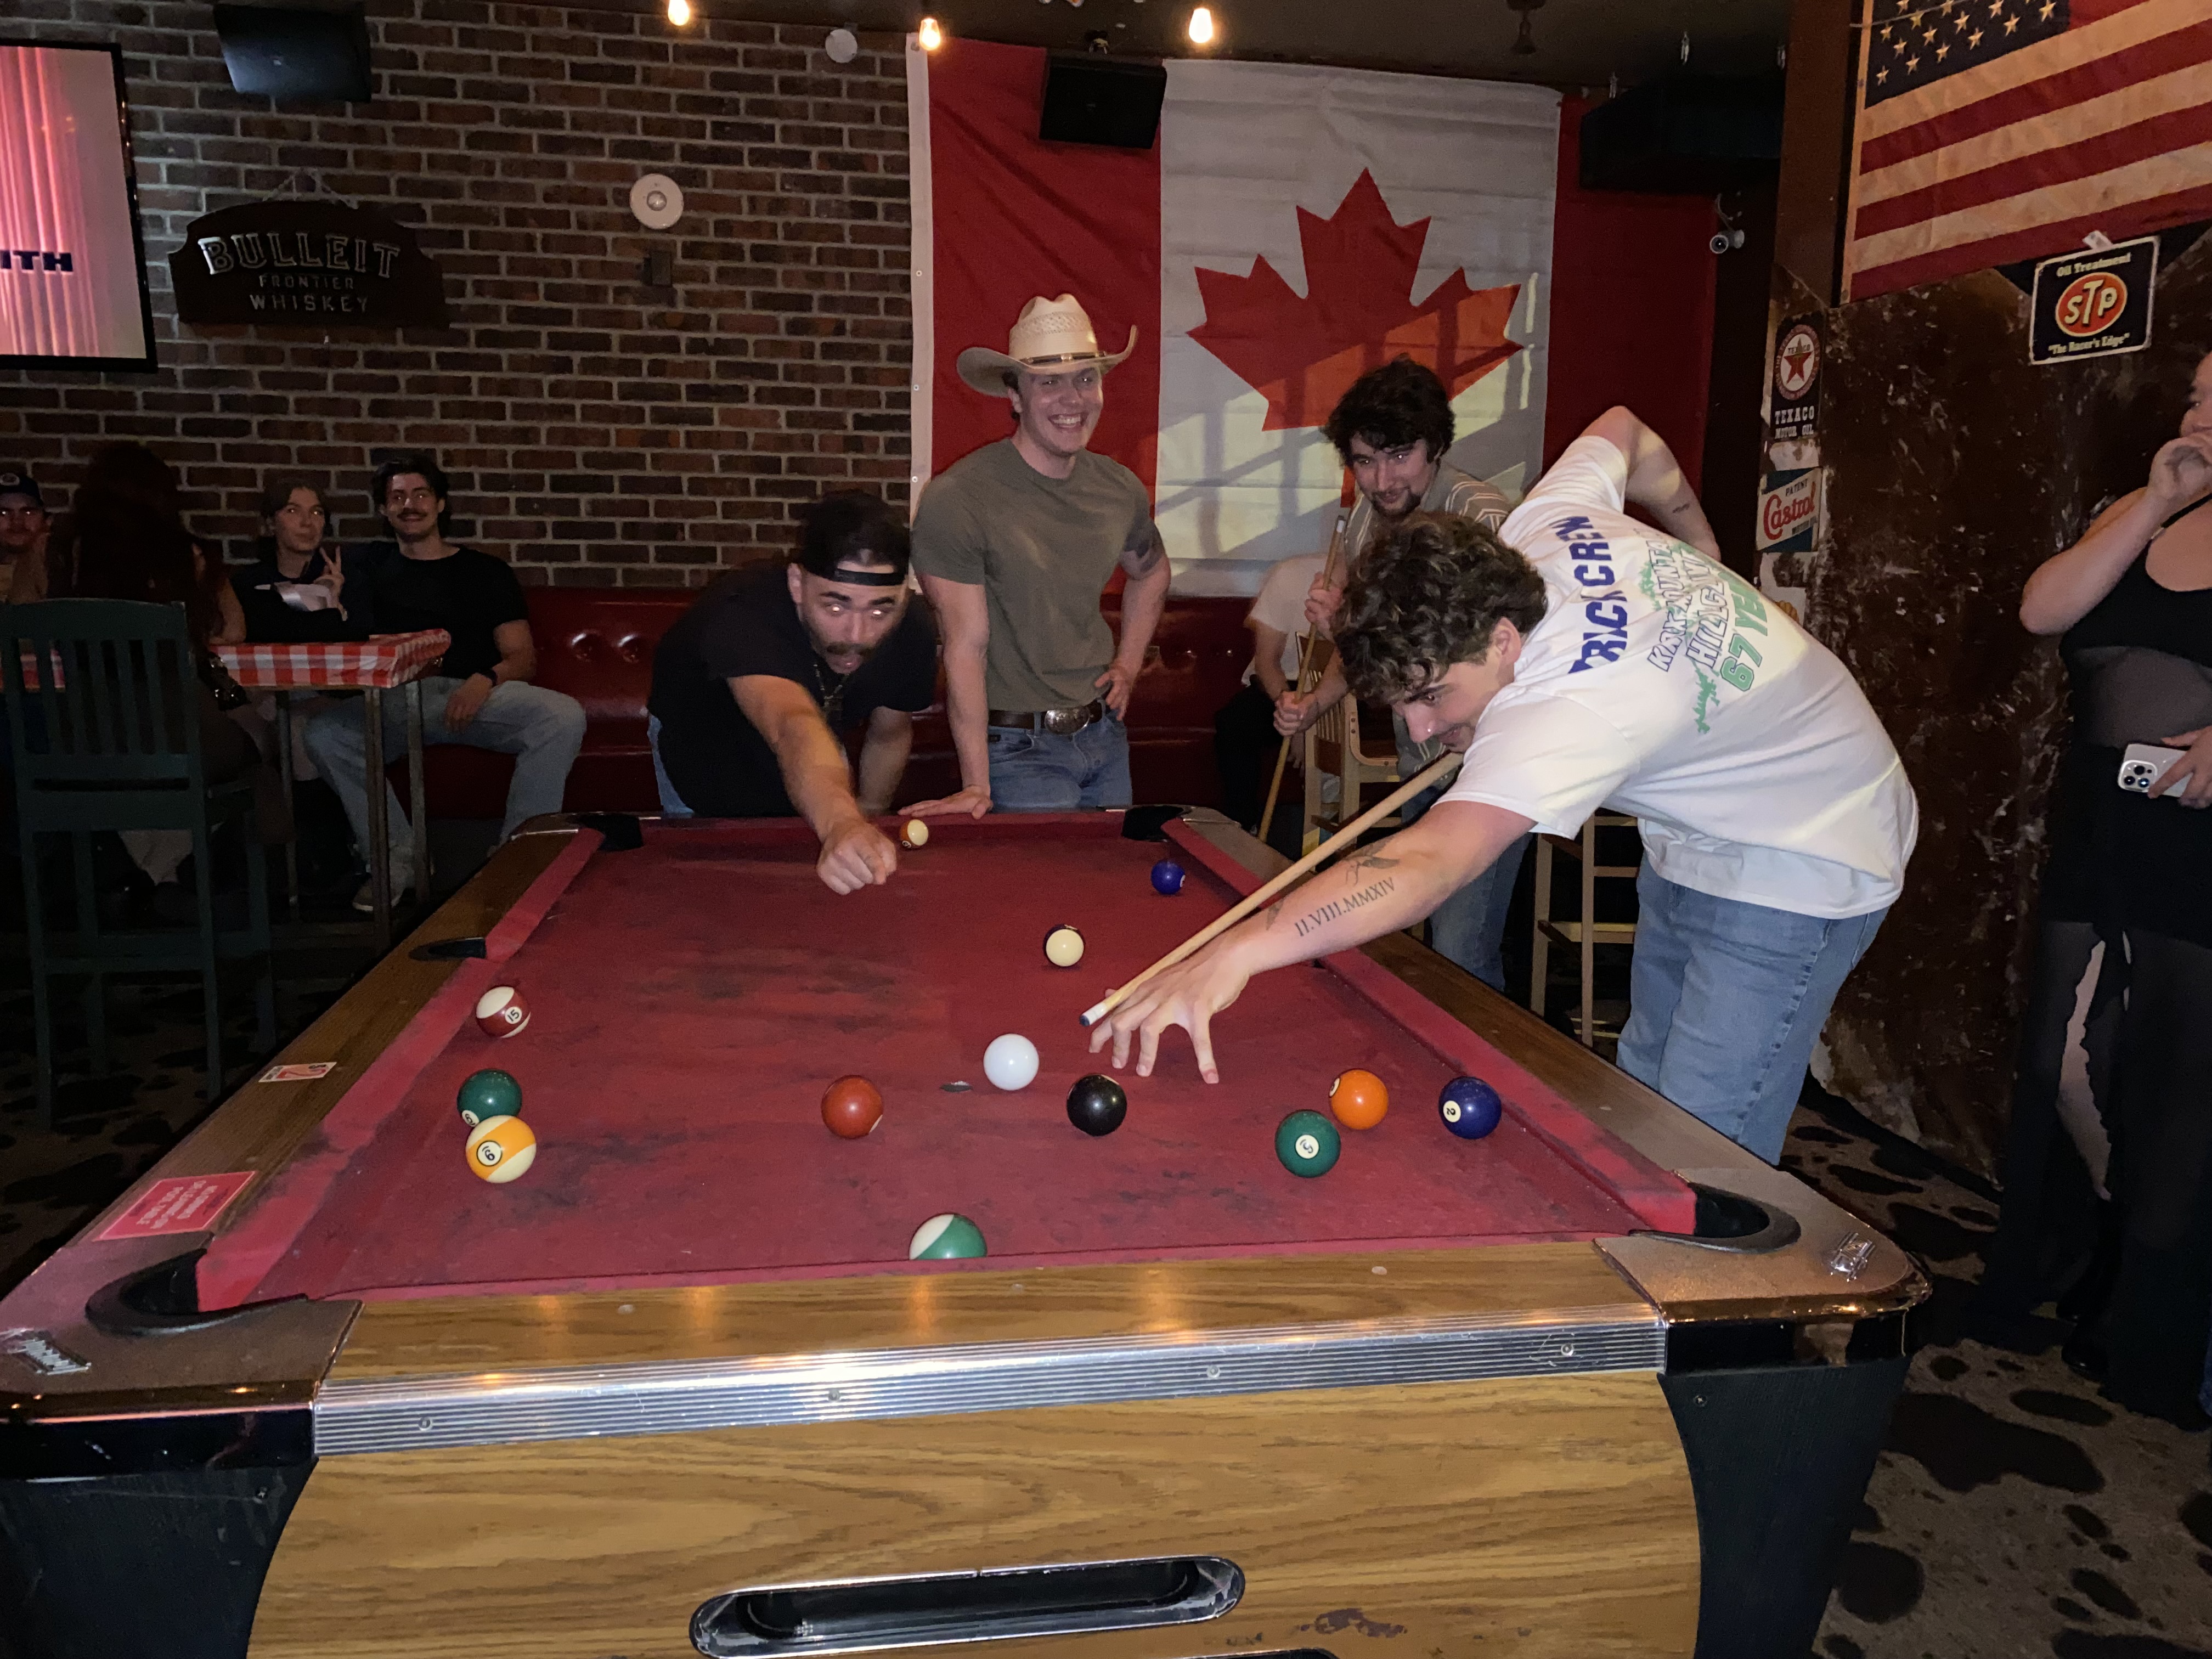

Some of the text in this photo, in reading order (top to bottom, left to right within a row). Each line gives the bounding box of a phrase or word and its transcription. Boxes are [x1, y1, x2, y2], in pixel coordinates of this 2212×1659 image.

[198, 232, 400, 278] BULLEIT
[250, 294, 368, 313] WHISKEY
[259, 275, 353, 290] FRONTIER
[2064, 279, 2118, 324] STP
[1775, 405, 1815, 425] TEXACO
[1763, 481, 1816, 540] Castrol
[1548, 516, 1615, 586] CREW
[1720, 633, 1763, 692] 67
[507, 1009, 520, 1022] 15
